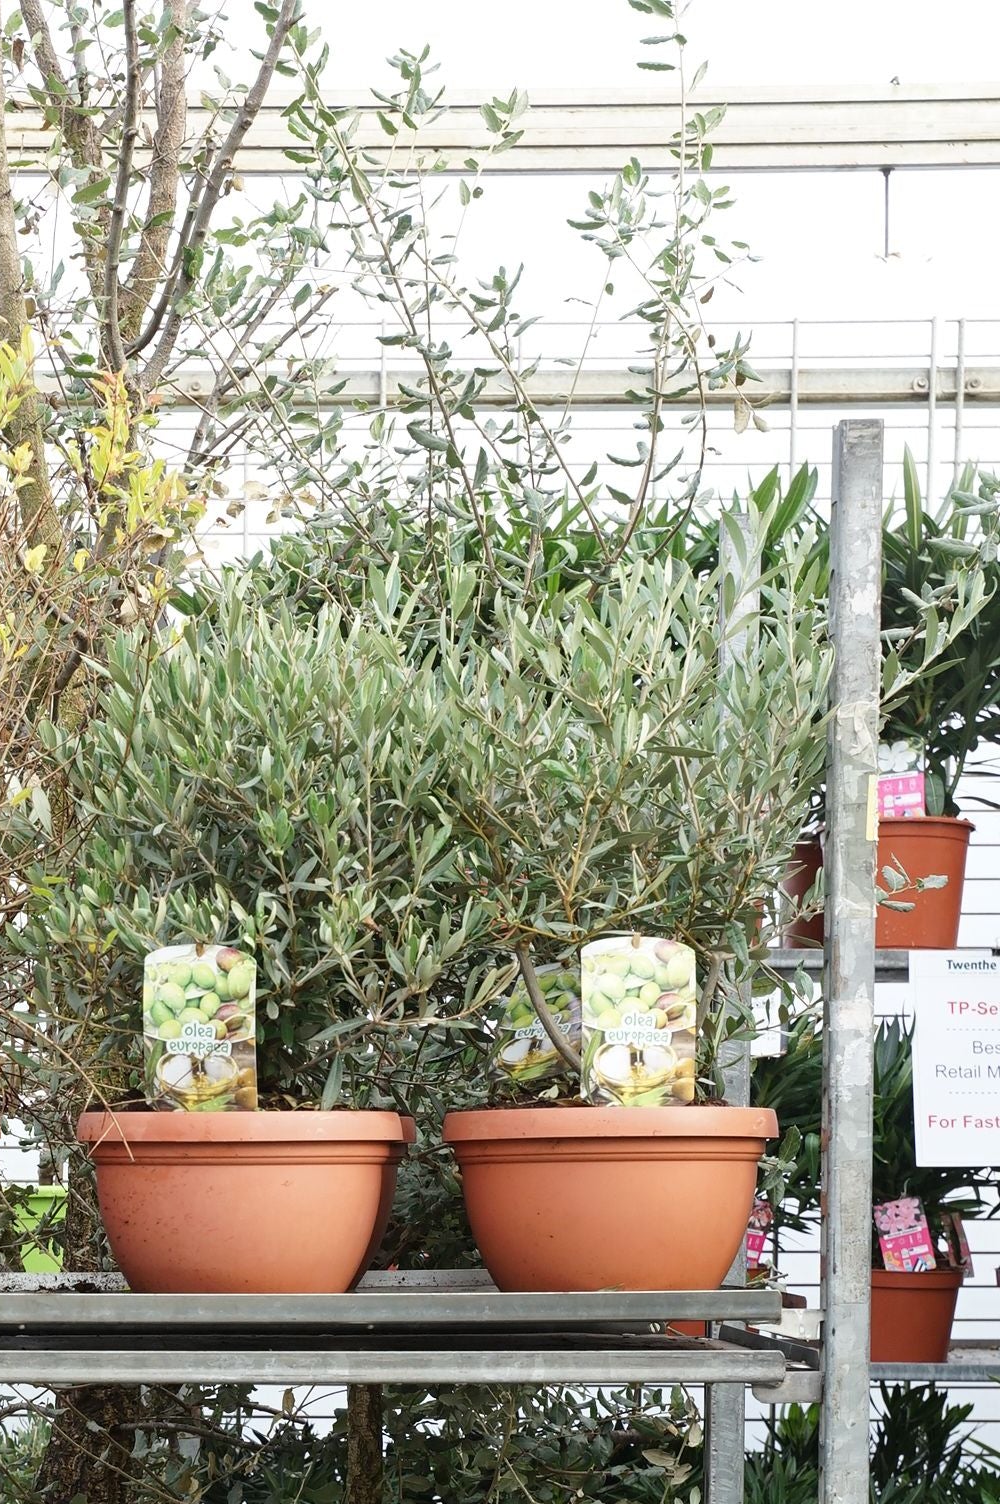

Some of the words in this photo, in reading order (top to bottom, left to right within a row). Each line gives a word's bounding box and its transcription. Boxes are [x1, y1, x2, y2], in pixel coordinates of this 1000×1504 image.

[945, 959, 997, 970] Twenthe
[608, 1030, 669, 1046] europaea
[169, 1041, 229, 1056] europaea
[935, 1064, 981, 1079] Retail
[928, 1115, 957, 1129] For
